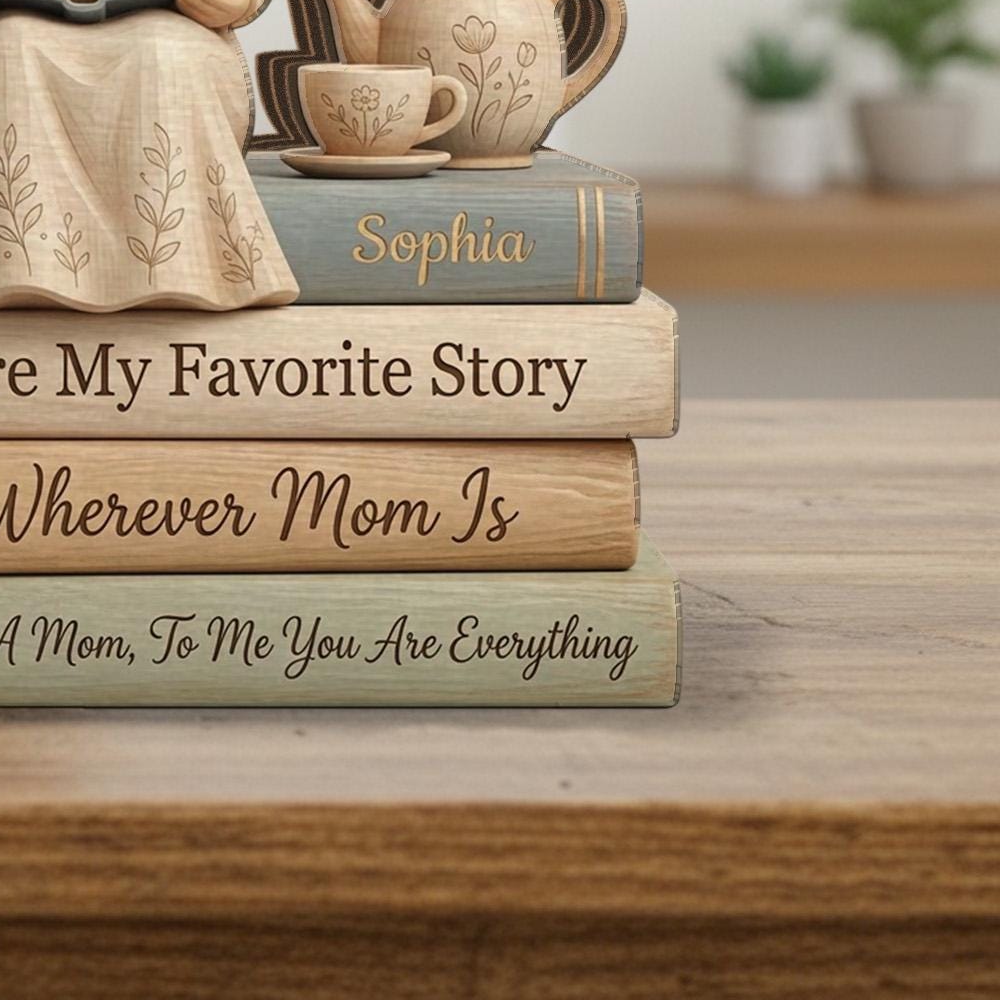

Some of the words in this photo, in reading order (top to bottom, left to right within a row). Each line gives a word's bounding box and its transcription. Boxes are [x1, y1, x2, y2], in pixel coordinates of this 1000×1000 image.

[352, 211, 535, 286] Sophia
[55, 342, 152, 412] My
[168, 339, 413, 397] Favorite
[431, 341, 588, 412] Story
[270, 467, 441, 550] Mom
[451, 466, 519, 544] Is
[31, 616, 137, 667] Mom,
[149, 613, 199, 665] To
[207, 615, 274, 667] Me
[282, 615, 361, 680] You
[365, 614, 442, 666] Are
[449, 614, 639, 682] Everything
